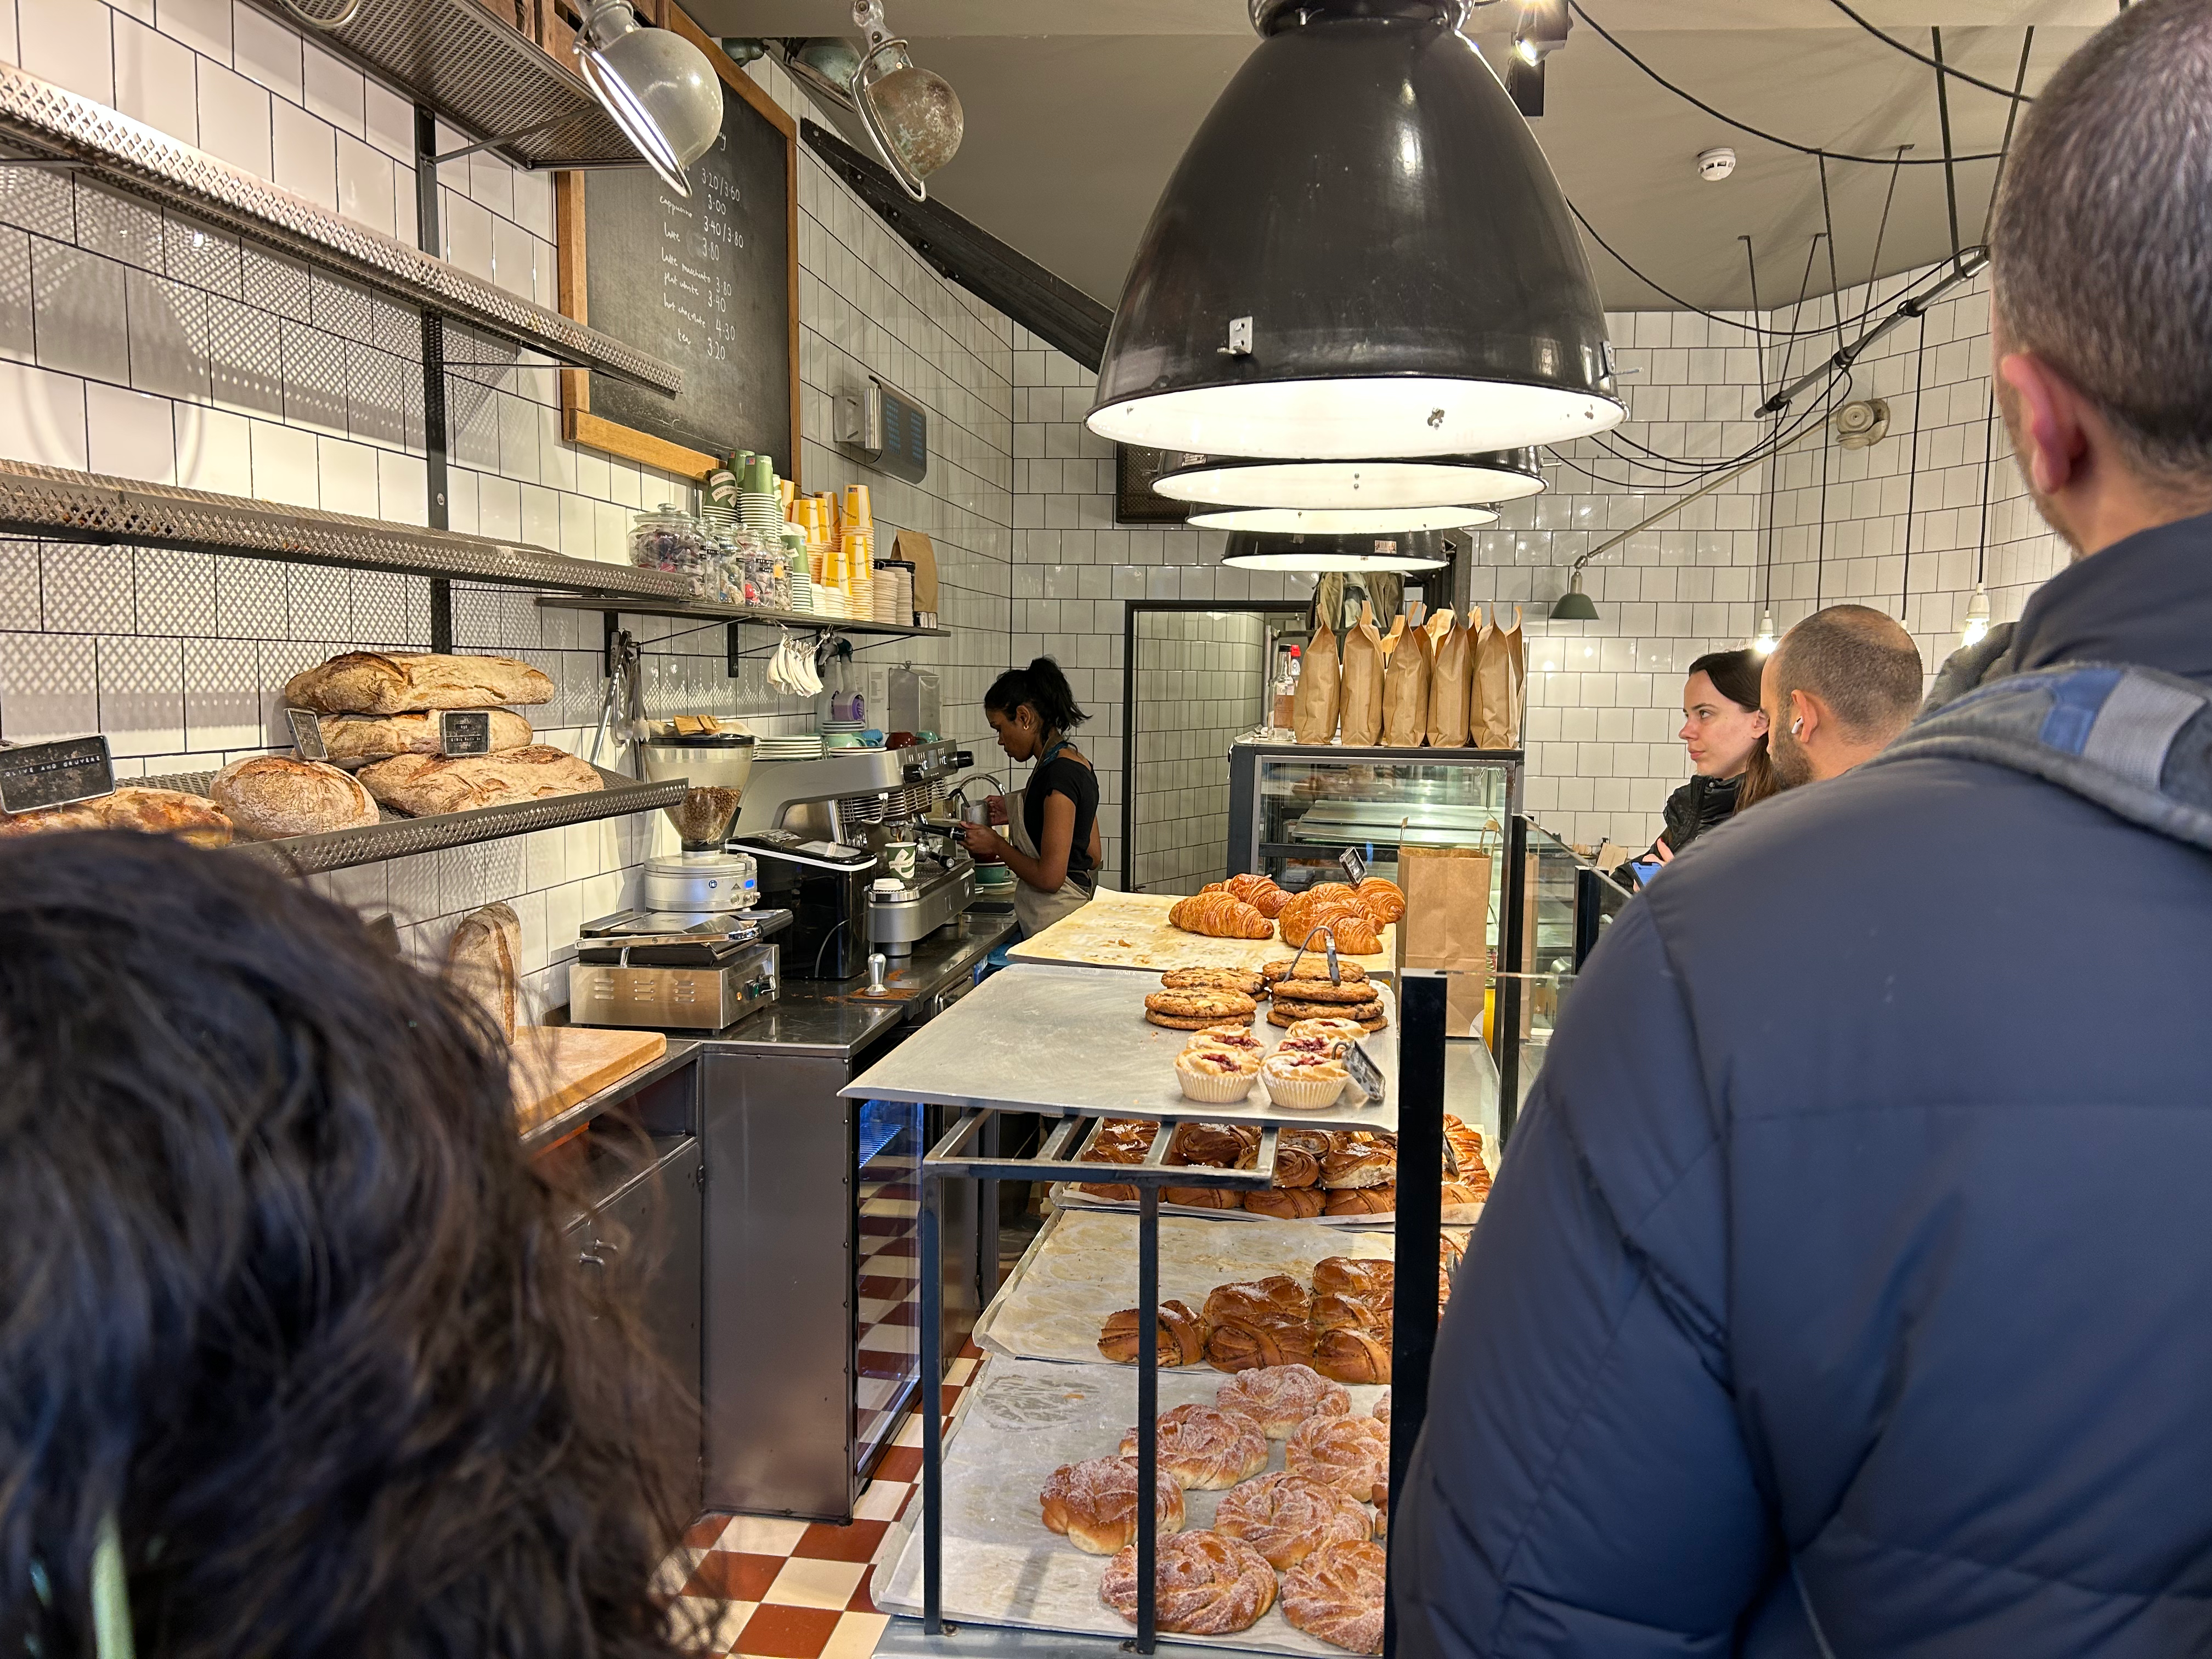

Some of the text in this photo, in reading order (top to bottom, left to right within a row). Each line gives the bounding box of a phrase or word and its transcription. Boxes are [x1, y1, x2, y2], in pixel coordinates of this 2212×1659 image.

[708, 194, 726, 215] 3.00
[702, 237, 720, 261] 3.80
[664, 272, 726, 313] flat white 3.40
[716, 276, 732, 296] 3.80
[663, 292, 676, 312] hot
[715, 318, 736, 341] 4.30
[678, 328, 726, 360] tea 3.20
[4, 766, 34, 777] OLIVE
[41, 763, 57, 771] AND
